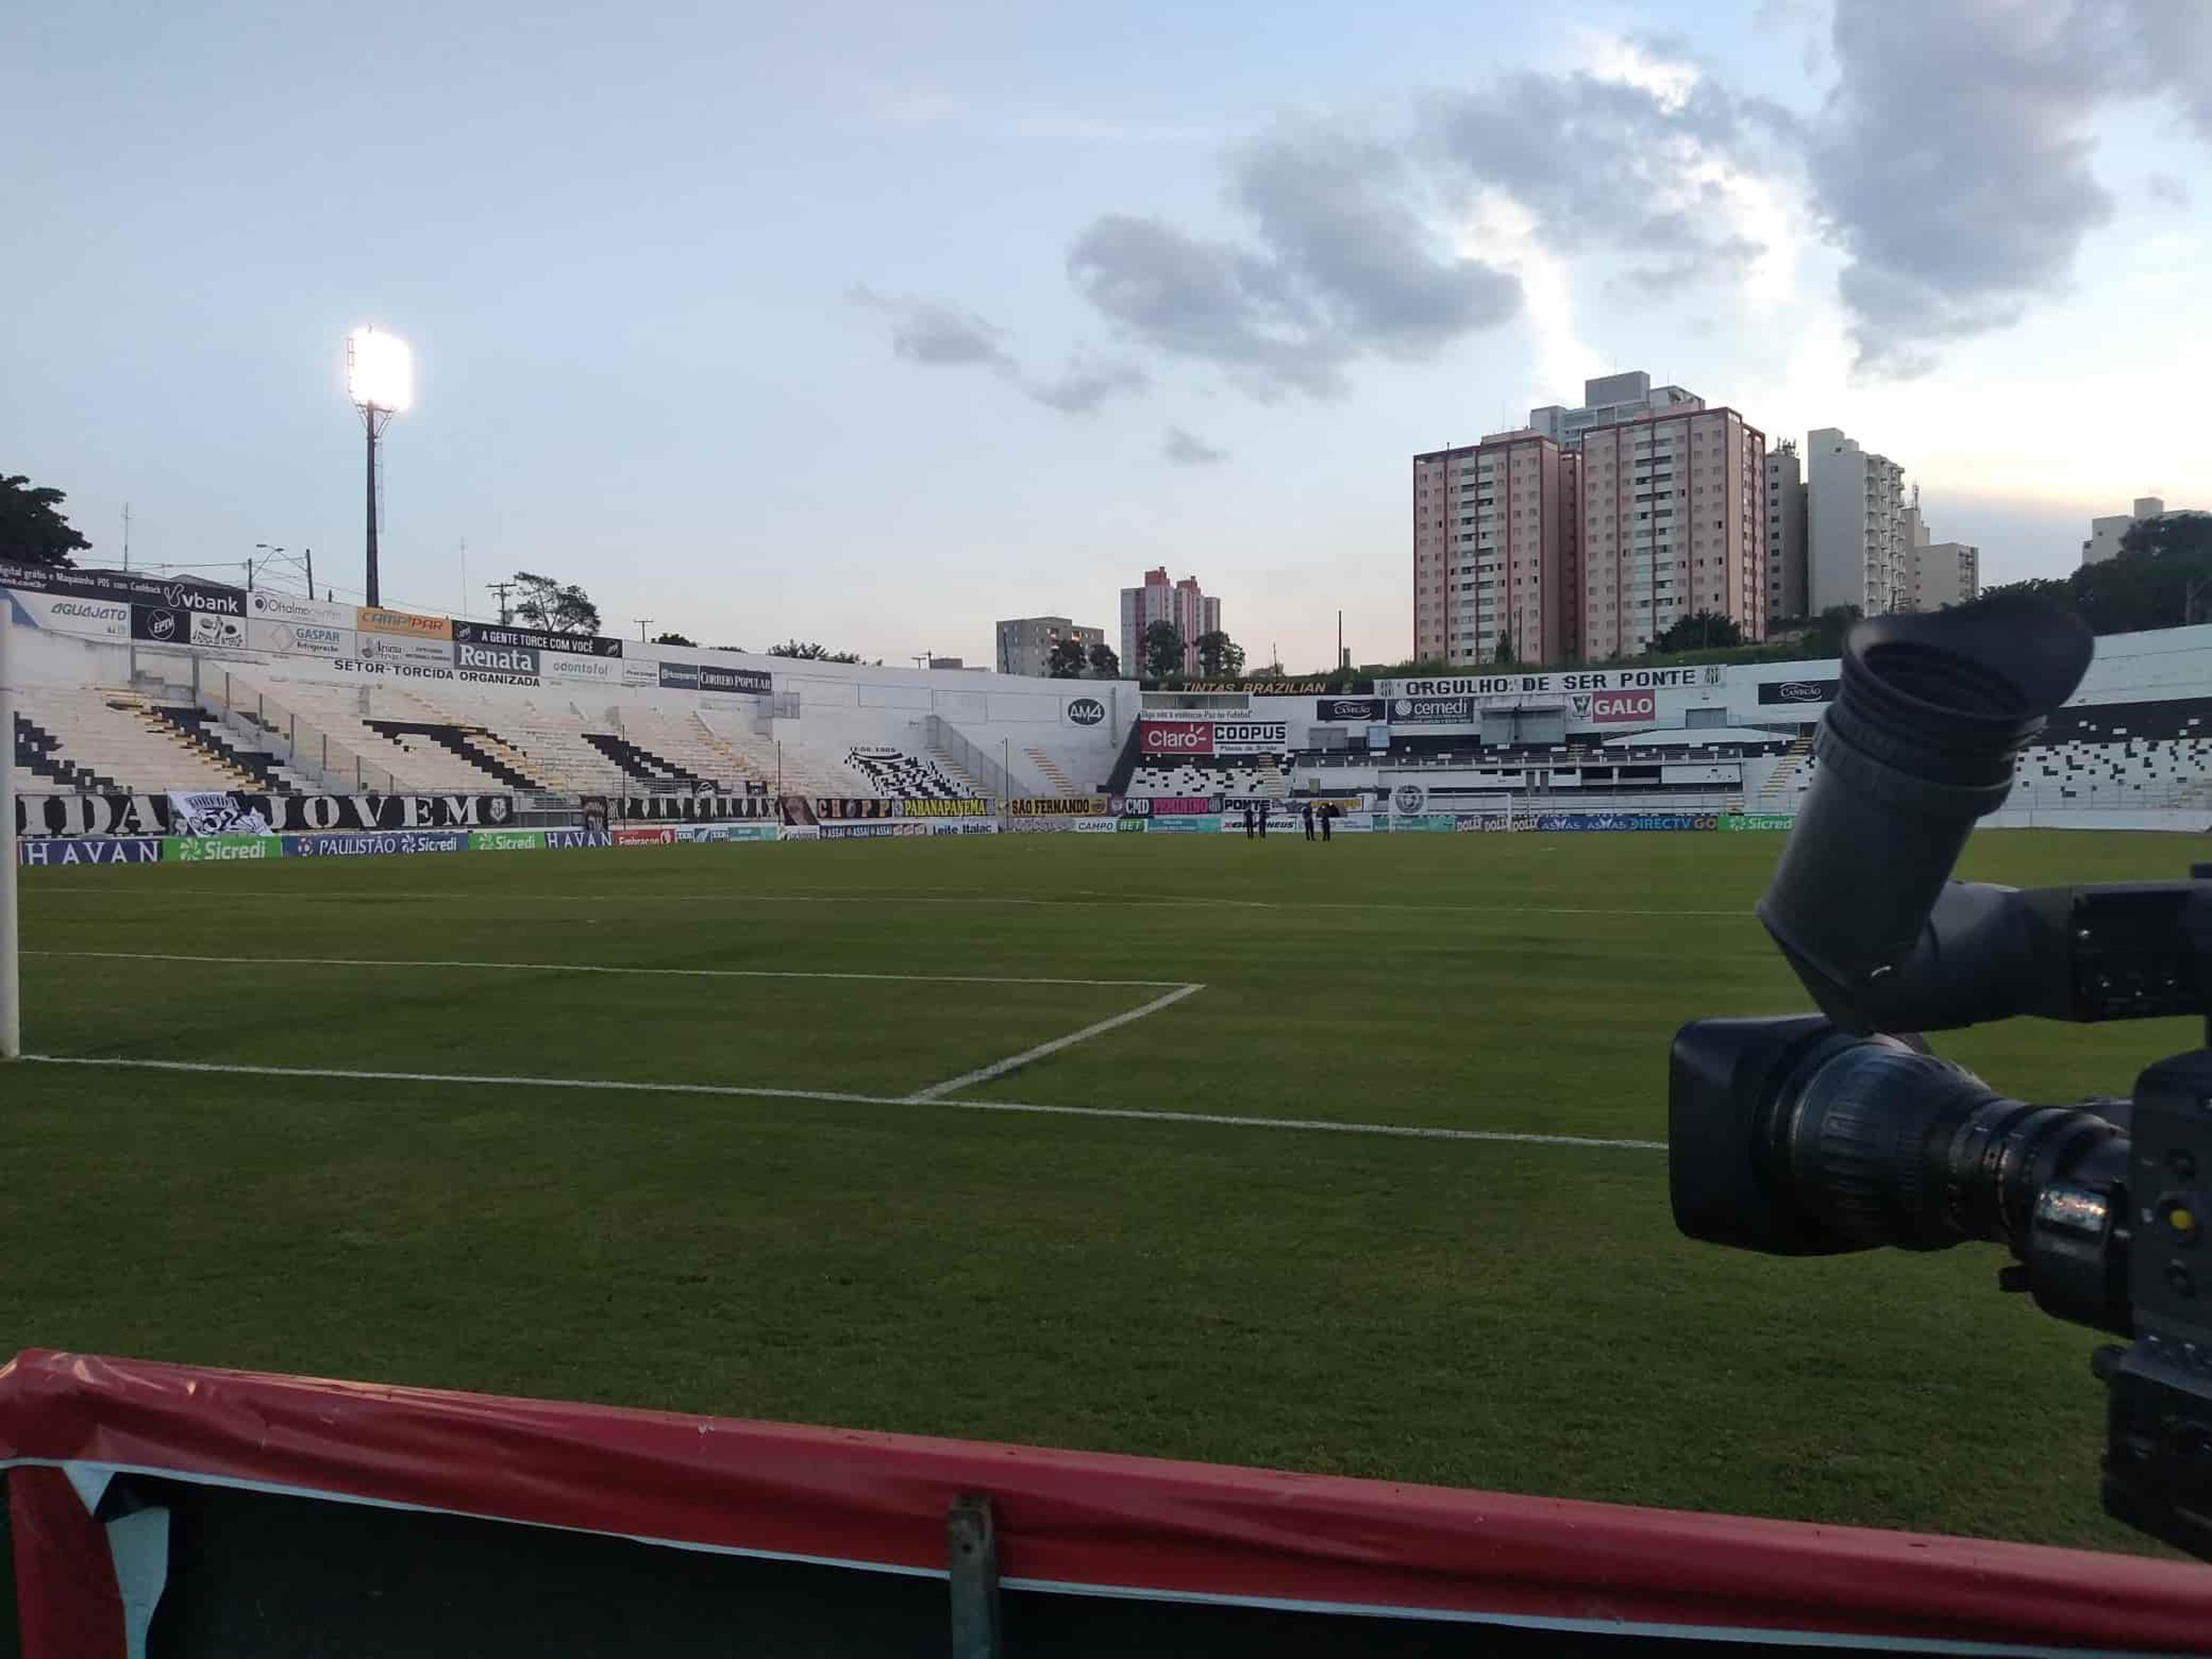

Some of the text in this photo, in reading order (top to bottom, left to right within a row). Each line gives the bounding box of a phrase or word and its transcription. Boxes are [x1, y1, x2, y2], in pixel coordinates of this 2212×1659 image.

[183, 592, 238, 613] vbank
[296, 627, 340, 642] GASPAR
[481, 630, 489, 641] A
[490, 631, 518, 646] GENTE
[520, 636, 548, 647] TORCE
[549, 638, 570, 651] COM
[571, 639, 594, 654] VOCÊ
[459, 643, 533, 671] Renata
[460, 671, 540, 687] ORGANIZADA
[1183, 682, 1327, 693] TINTAS BRAZILIAN
[1406, 669, 1695, 696] ORGULHO DE SER PONTE
[1069, 704, 1103, 719] AM4
[1594, 698, 1652, 715] GALO
[1149, 730, 1200, 748] Claro
[1215, 726, 1285, 740] COOPUS
[268, 795, 480, 829] JOVEM
[1034, 799, 1089, 814] FERNANDO
[1125, 798, 1150, 815] CMD
[1078, 822, 1113, 831] CAMPO
[1694, 818, 1717, 829] GO
[319, 836, 457, 855] PAULISTÃO Sicredi
[496, 834, 535, 850] Sicredi
[548, 831, 612, 847] HAVAN
[26, 841, 159, 864] HAVAN
[204, 841, 266, 860] Sicredi
